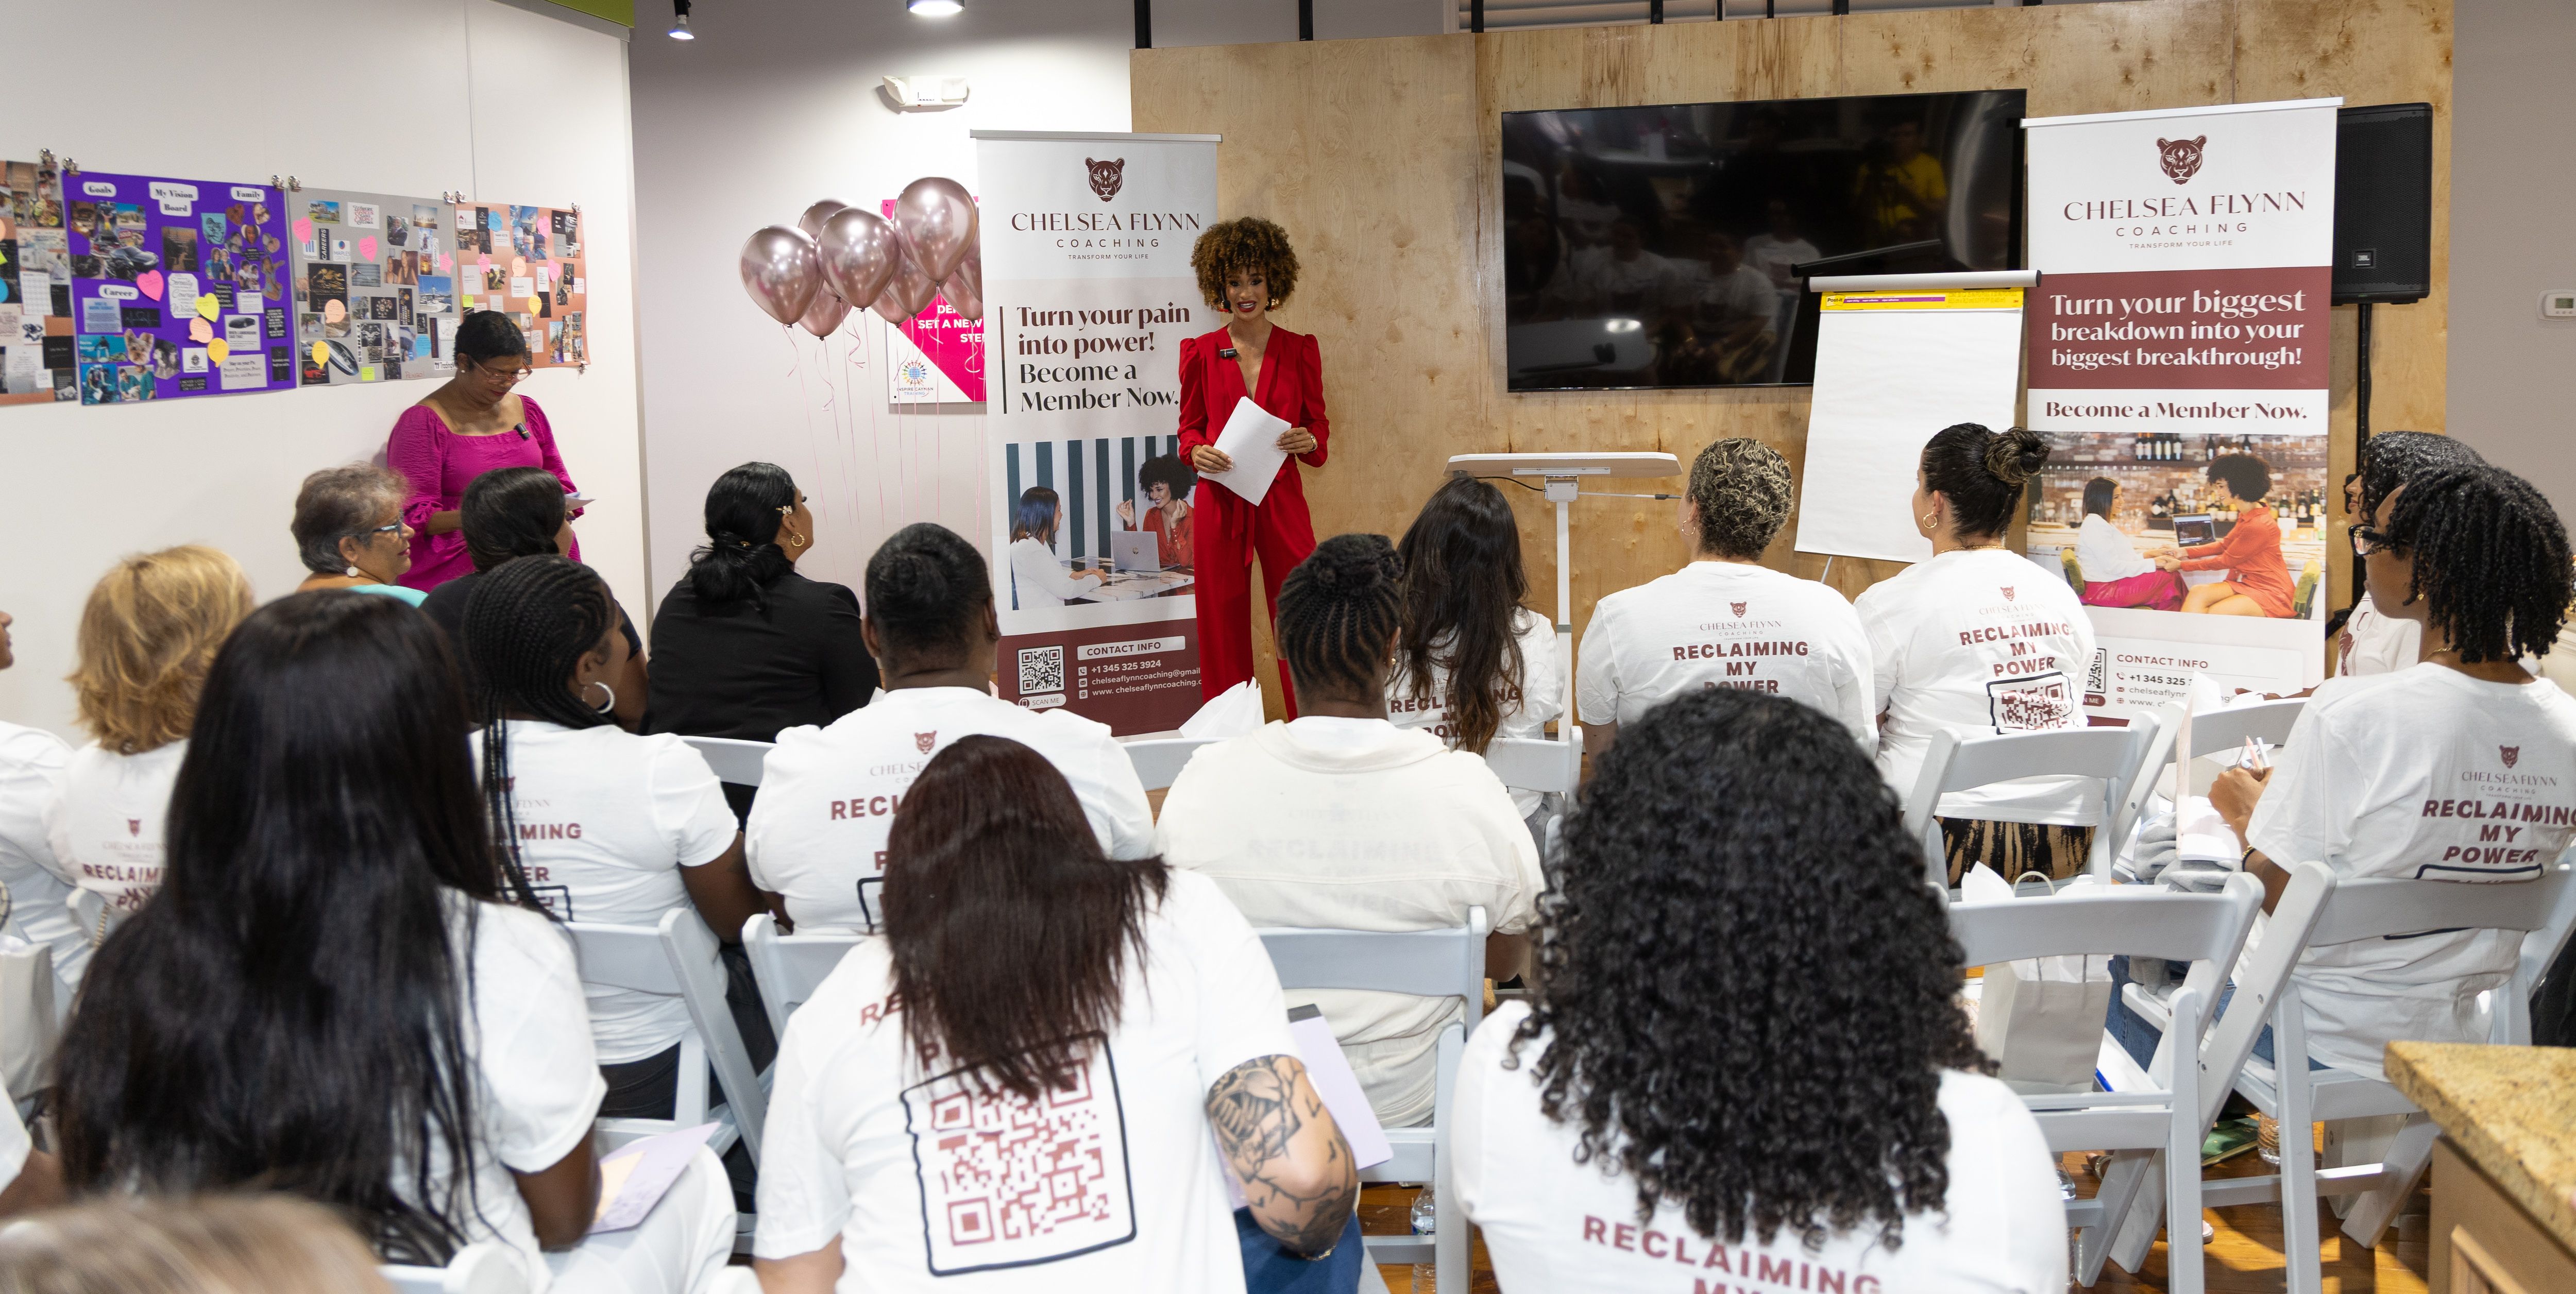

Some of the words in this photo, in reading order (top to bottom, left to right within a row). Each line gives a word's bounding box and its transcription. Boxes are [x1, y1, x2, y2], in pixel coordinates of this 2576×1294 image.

[88, 185, 112, 194] Goals
[155, 189, 166, 198] My
[169, 189, 193, 199] Vision
[236, 190, 261, 200] Family
[164, 203, 188, 213] Board
[2064, 197, 2198, 220] CHELSEA
[2210, 191, 2306, 215] FLYNN
[1011, 212, 1122, 232] CHELSEA
[1130, 213, 1200, 231] FLYNN
[2116, 222, 2248, 237] COACHING
[1057, 238, 1160, 248] COACHING
[104, 287, 133, 297] Career
[2049, 294, 2113, 316] Turn
[2119, 294, 2186, 320] your
[2193, 289, 2307, 319] biggest
[918, 319, 939, 329] SET
[942, 319, 952, 329] A
[954, 319, 983, 328] NEW
[1016, 306, 1074, 327] Turn
[1079, 308, 1137, 331] your
[1138, 301, 1190, 330] pain
[2051, 321, 2184, 342] breakdown
[2191, 320, 2240, 340] into
[2245, 323, 2304, 344] your
[1019, 333, 1068, 355] into
[1075, 332, 1155, 359] power!
[2052, 348, 2132, 370] biggest
[2137, 347, 2302, 370] breakthrough!
[1020, 363, 1119, 384] Become
[1124, 364, 1138, 380] a
[1021, 387, 1122, 412] Member
[1127, 387, 1180, 407] Now.
[2046, 401, 2133, 418] Become
[2138, 405, 2150, 418] a
[2155, 402, 2250, 419] Member
[2255, 402, 2308, 419] Now.
[1700, 621, 1747, 631] CHELSEA
[1750, 620, 1782, 628] FLYNN
[1959, 622, 2070, 646] RECLAIMING
[1087, 644, 1134, 657] CONTACT
[1137, 641, 1161, 652] INFO
[1672, 641, 1808, 661] RECLAIMING
[2010, 641, 2037, 656] MY
[1092, 666, 1101, 674] +1
[1103, 663, 1120, 673] 345
[1121, 662, 1139, 672] 325
[1140, 659, 1161, 670] 3924
[1726, 661, 1757, 676] MY
[1993, 657, 2056, 677] POWER
[2117, 654, 2174, 666] CONTACT
[2178, 659, 2208, 669] INFO
[1704, 679, 1780, 694] POWER
[2143, 675, 2163, 684] 345
[2166, 676, 2185, 686] 325
[1092, 688, 1114, 697] www.
[1391, 687, 1520, 713] RECLANG
[870, 761, 926, 776] CHELSE
[2462, 771, 2518, 785] CHELSEA
[2520, 774, 2558, 787] FLYNN
[2481, 785, 2536, 794] COACHING
[2479, 825, 2523, 843] MY
[2442, 846, 2539, 864] POWER
[1583, 1214, 1882, 1294] RECLAIMING
